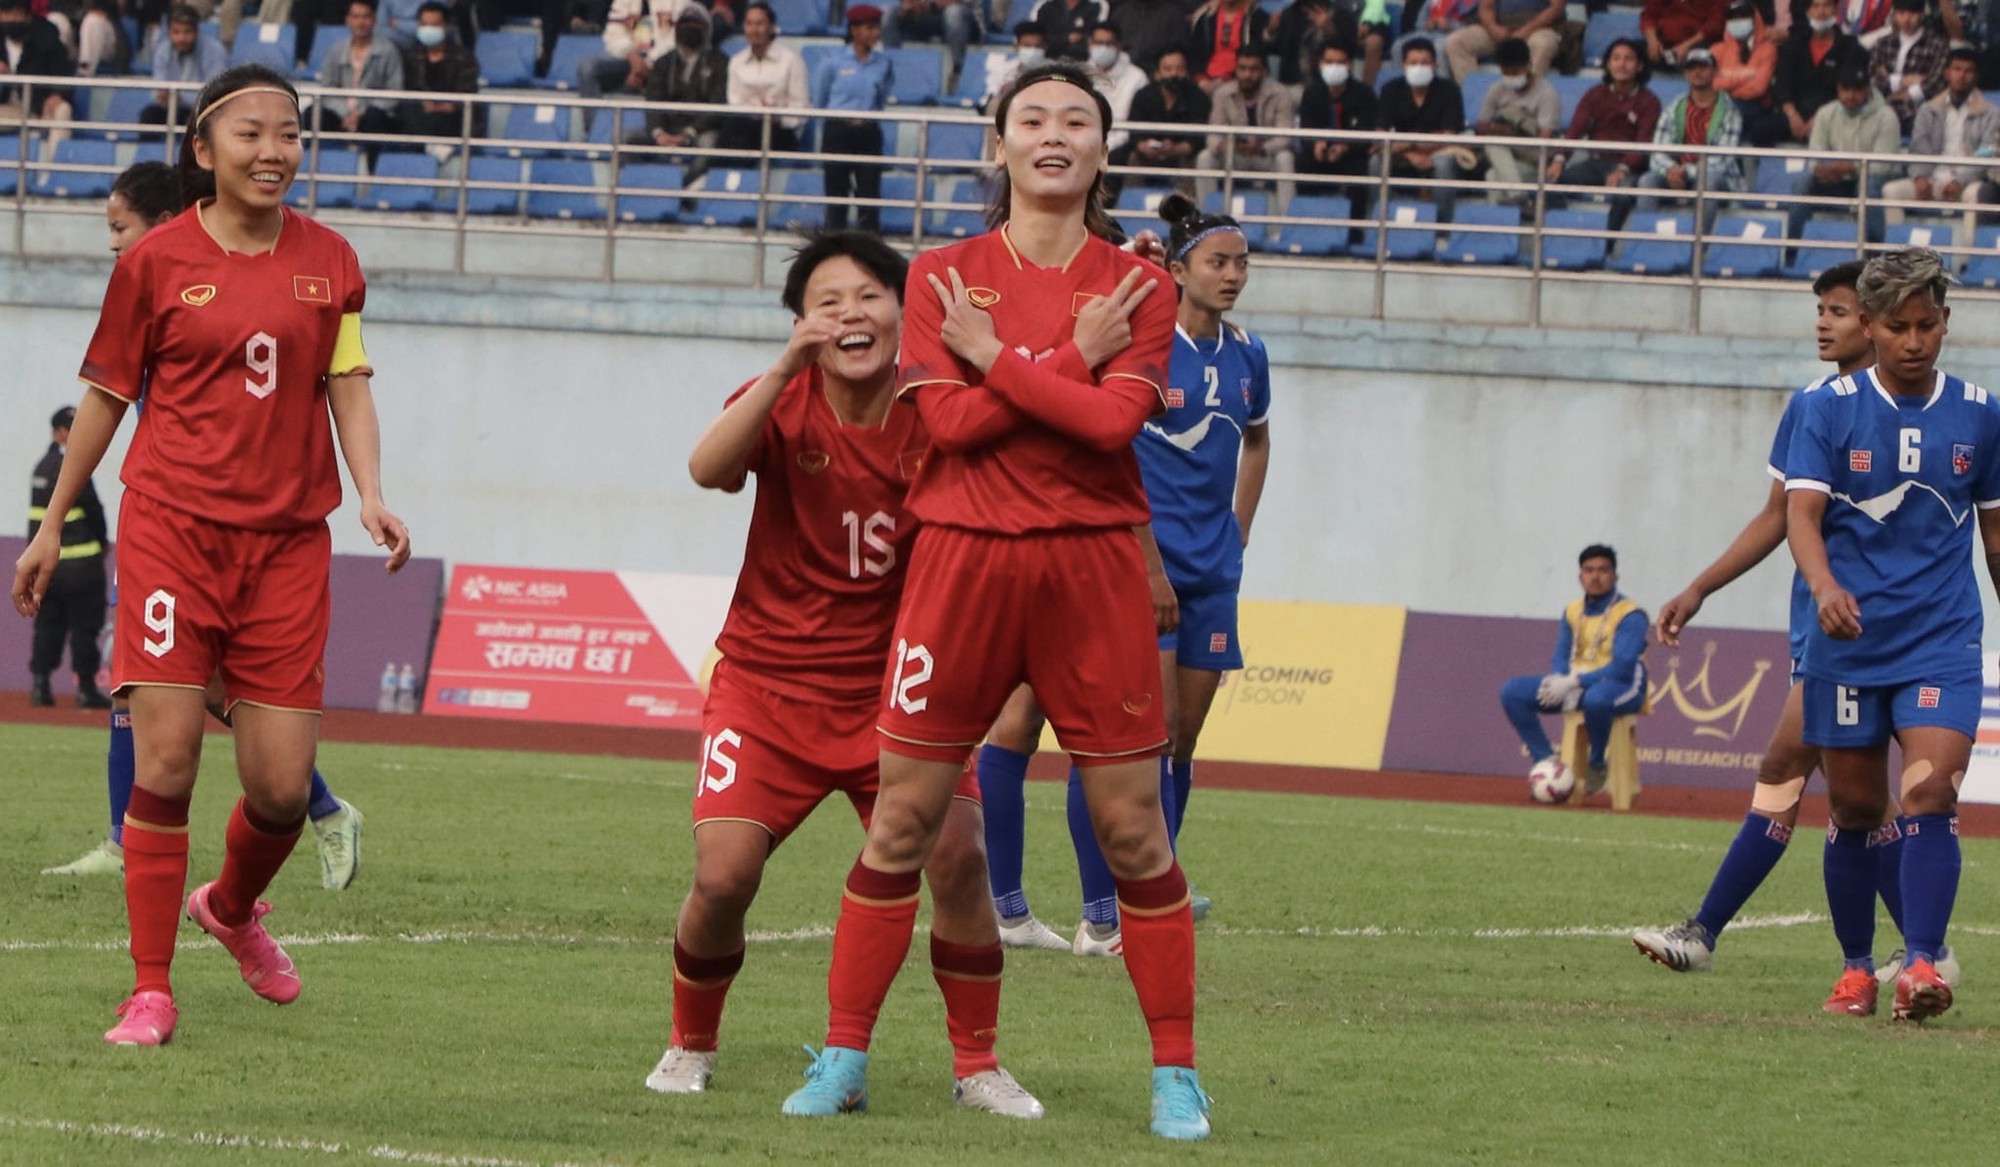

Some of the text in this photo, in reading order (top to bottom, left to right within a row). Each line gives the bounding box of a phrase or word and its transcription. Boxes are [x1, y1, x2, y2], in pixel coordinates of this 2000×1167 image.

[245, 331, 277, 399] 9
[1204, 366, 1221, 406] 2
[1898, 428, 1922, 473] 6
[842, 510, 896, 578] 15
[144, 589, 175, 658] 9
[485, 641, 580, 671] सम्भव
[889, 637, 934, 715] 12
[1244, 666, 1333, 684] COMING
[1240, 687, 1306, 704] SOON
[1837, 685, 1859, 726] 6
[697, 727, 742, 798] 15
[1665, 749, 1741, 767] RESEARCH
